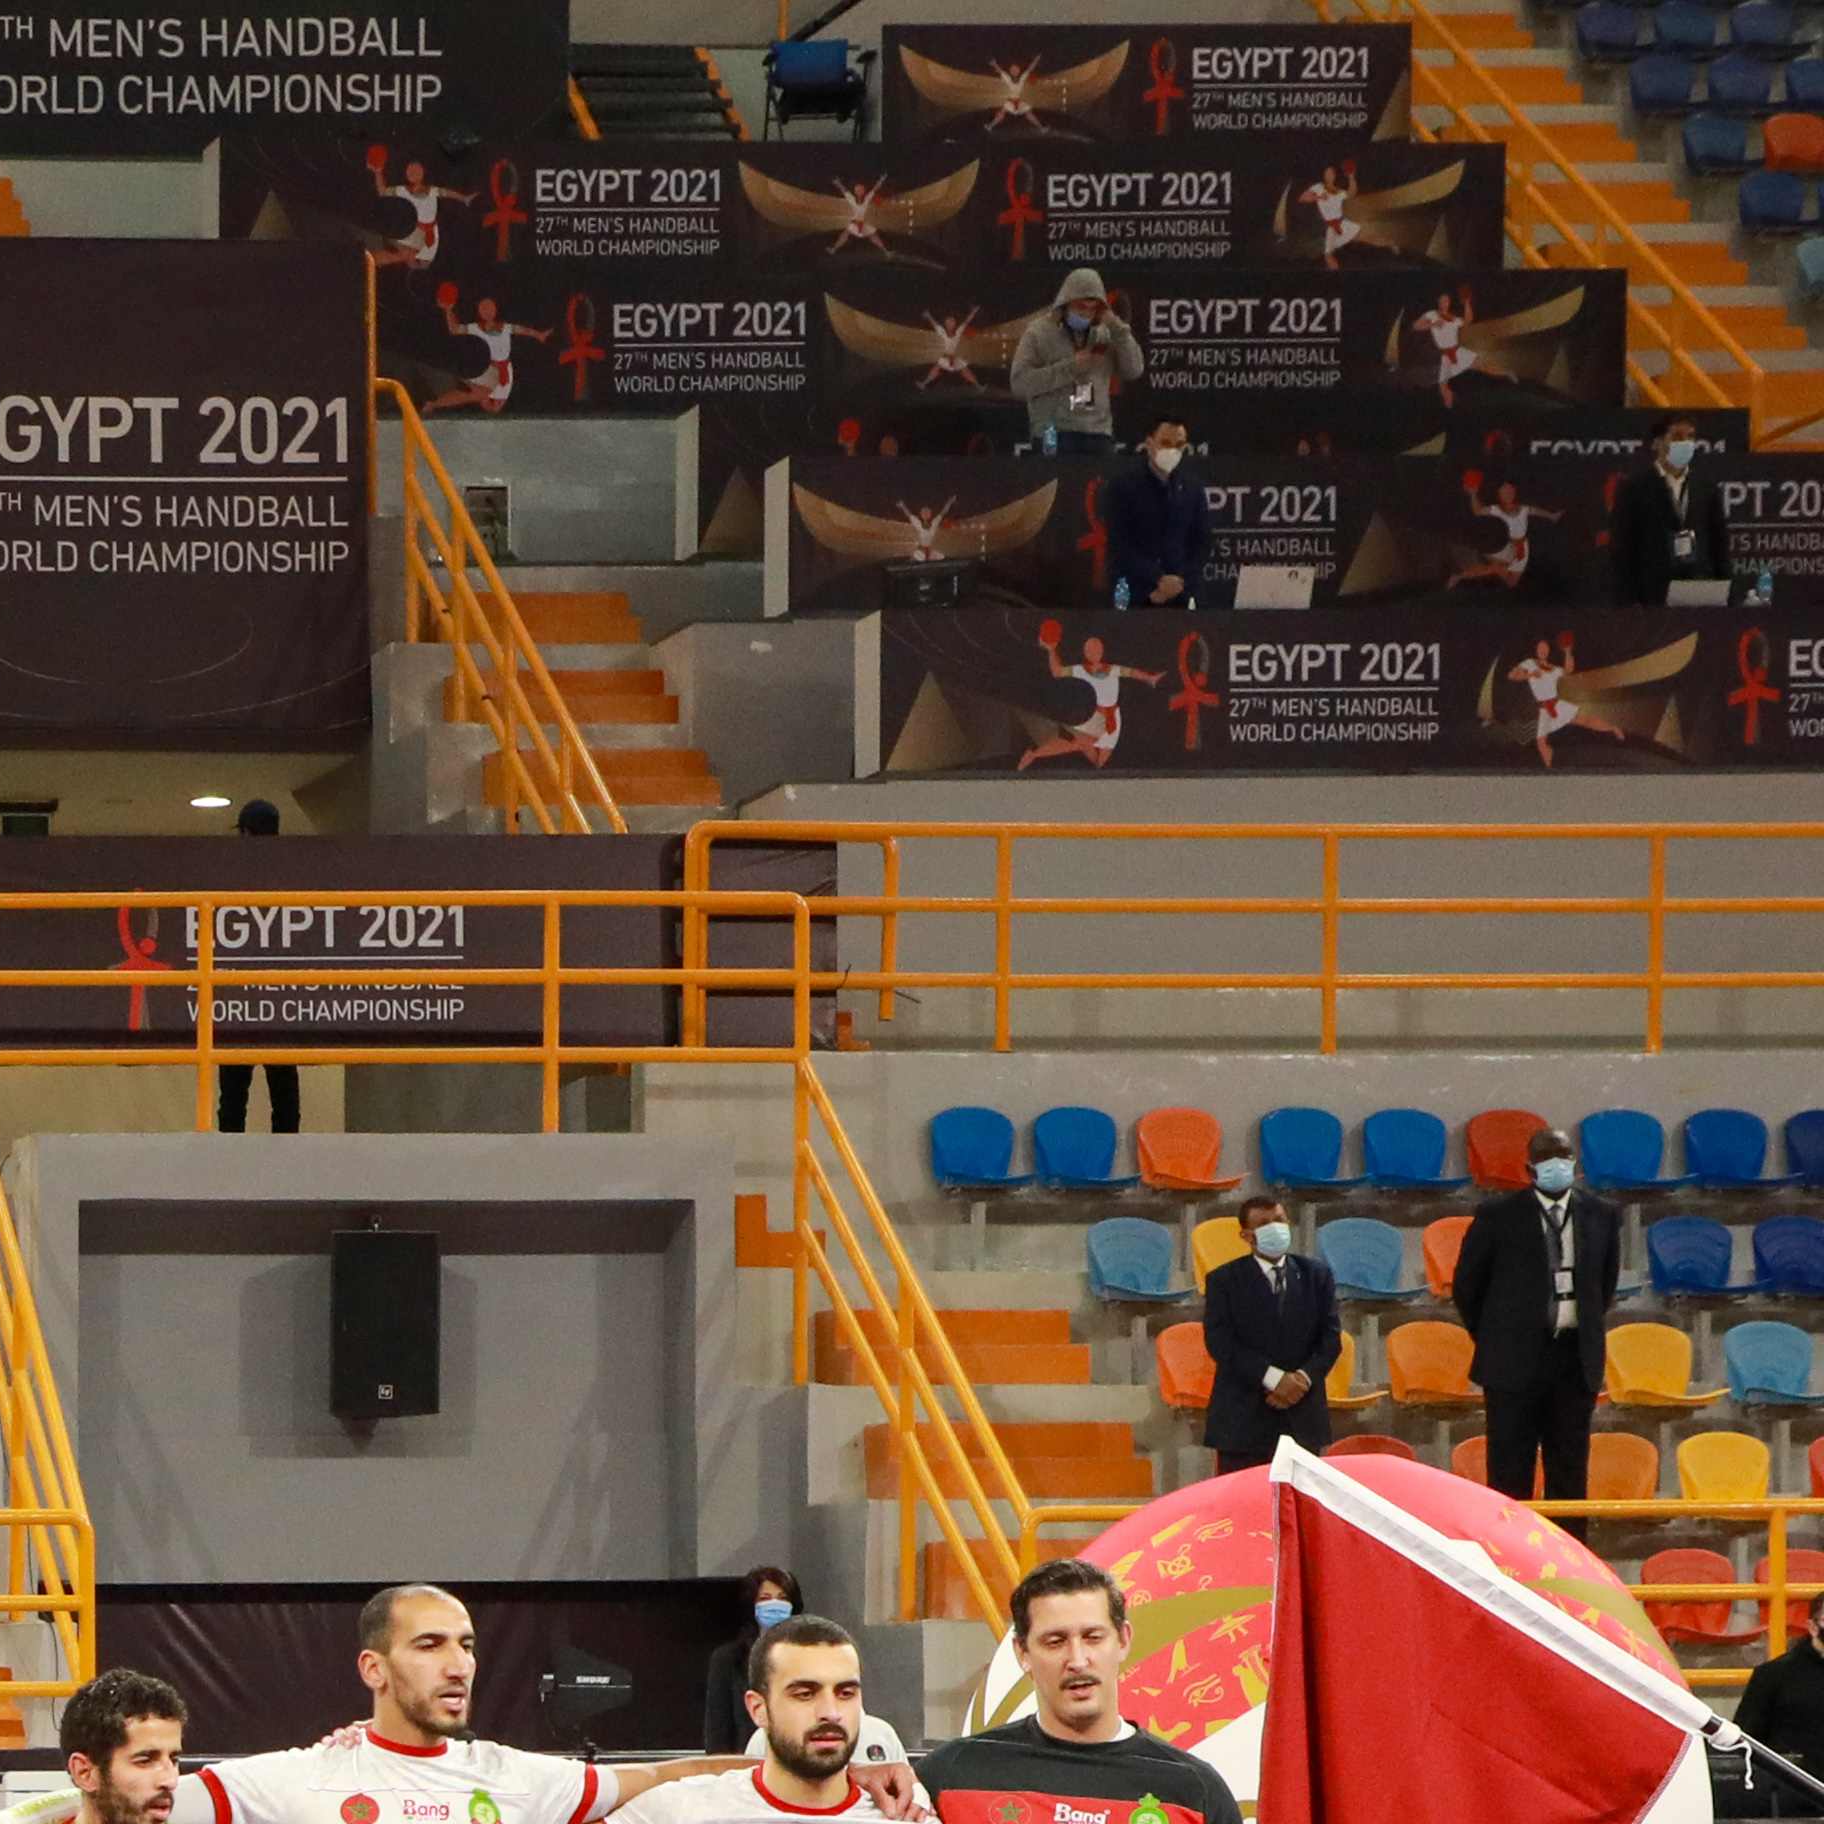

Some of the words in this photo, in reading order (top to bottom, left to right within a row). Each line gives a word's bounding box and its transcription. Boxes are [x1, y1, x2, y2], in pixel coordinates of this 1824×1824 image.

[49, 17, 185, 59] MEN'S
[200, 16, 443, 58] HANDBALL
[1191, 46, 1295, 80] EGYPT
[1300, 46, 1369, 79] 2021
[117, 73, 442, 115] CHAMPIONSHIP
[1192, 112, 1249, 131] WORLD
[1250, 110, 1369, 130] CHAMPIONSHIP
[535, 168, 643, 203] EGYPT
[649, 168, 721, 203] 2021
[1047, 172, 1154, 208] EGYPT
[1161, 170, 1232, 206] 2021
[628, 216, 721, 235] HANDBALL
[1139, 218, 1232, 238] HANDBALL
[535, 238, 595, 257] WORLD
[597, 238, 721, 257] CHAMPIONSHIP
[1047, 242, 1108, 262] WORLD
[1109, 240, 1232, 261] CHAMPIONSHIP
[612, 302, 725, 339] EGYPT
[732, 301, 806, 337] 2021
[1148, 298, 1261, 335] EGYPT
[1268, 297, 1342, 334] 2021
[652, 351, 707, 371] MEN'S
[710, 350, 806, 369] HANDBALL
[1245, 346, 1341, 366] HANDBALL
[613, 374, 676, 394] WORLD
[678, 373, 807, 393] CHAMPIONSHIP
[1148, 370, 1211, 390] WORLD
[1212, 368, 1342, 389] CHAMPIONSHIP
[198, 396, 348, 465] 2021
[34, 494, 143, 528] MEN'S
[155, 495, 349, 528] HANDBALL
[1259, 485, 1338, 523] 2021
[88, 540, 350, 573] CHAMPIONSHIP
[1236, 535, 1334, 557] HANDBALL
[1228, 643, 1351, 683] EGYPT
[1359, 642, 1440, 682] 2021
[1271, 697, 1331, 718] MEN'S
[1335, 696, 1440, 717] HANDBALL
[1228, 722, 1297, 743] WORLD
[1299, 721, 1440, 743] CHAMPIONSHIP
[359, 906, 465, 948] 2021
[281, 998, 465, 1022] CHAMPIONSHIP
[402, 1804, 448, 1820] Bang
